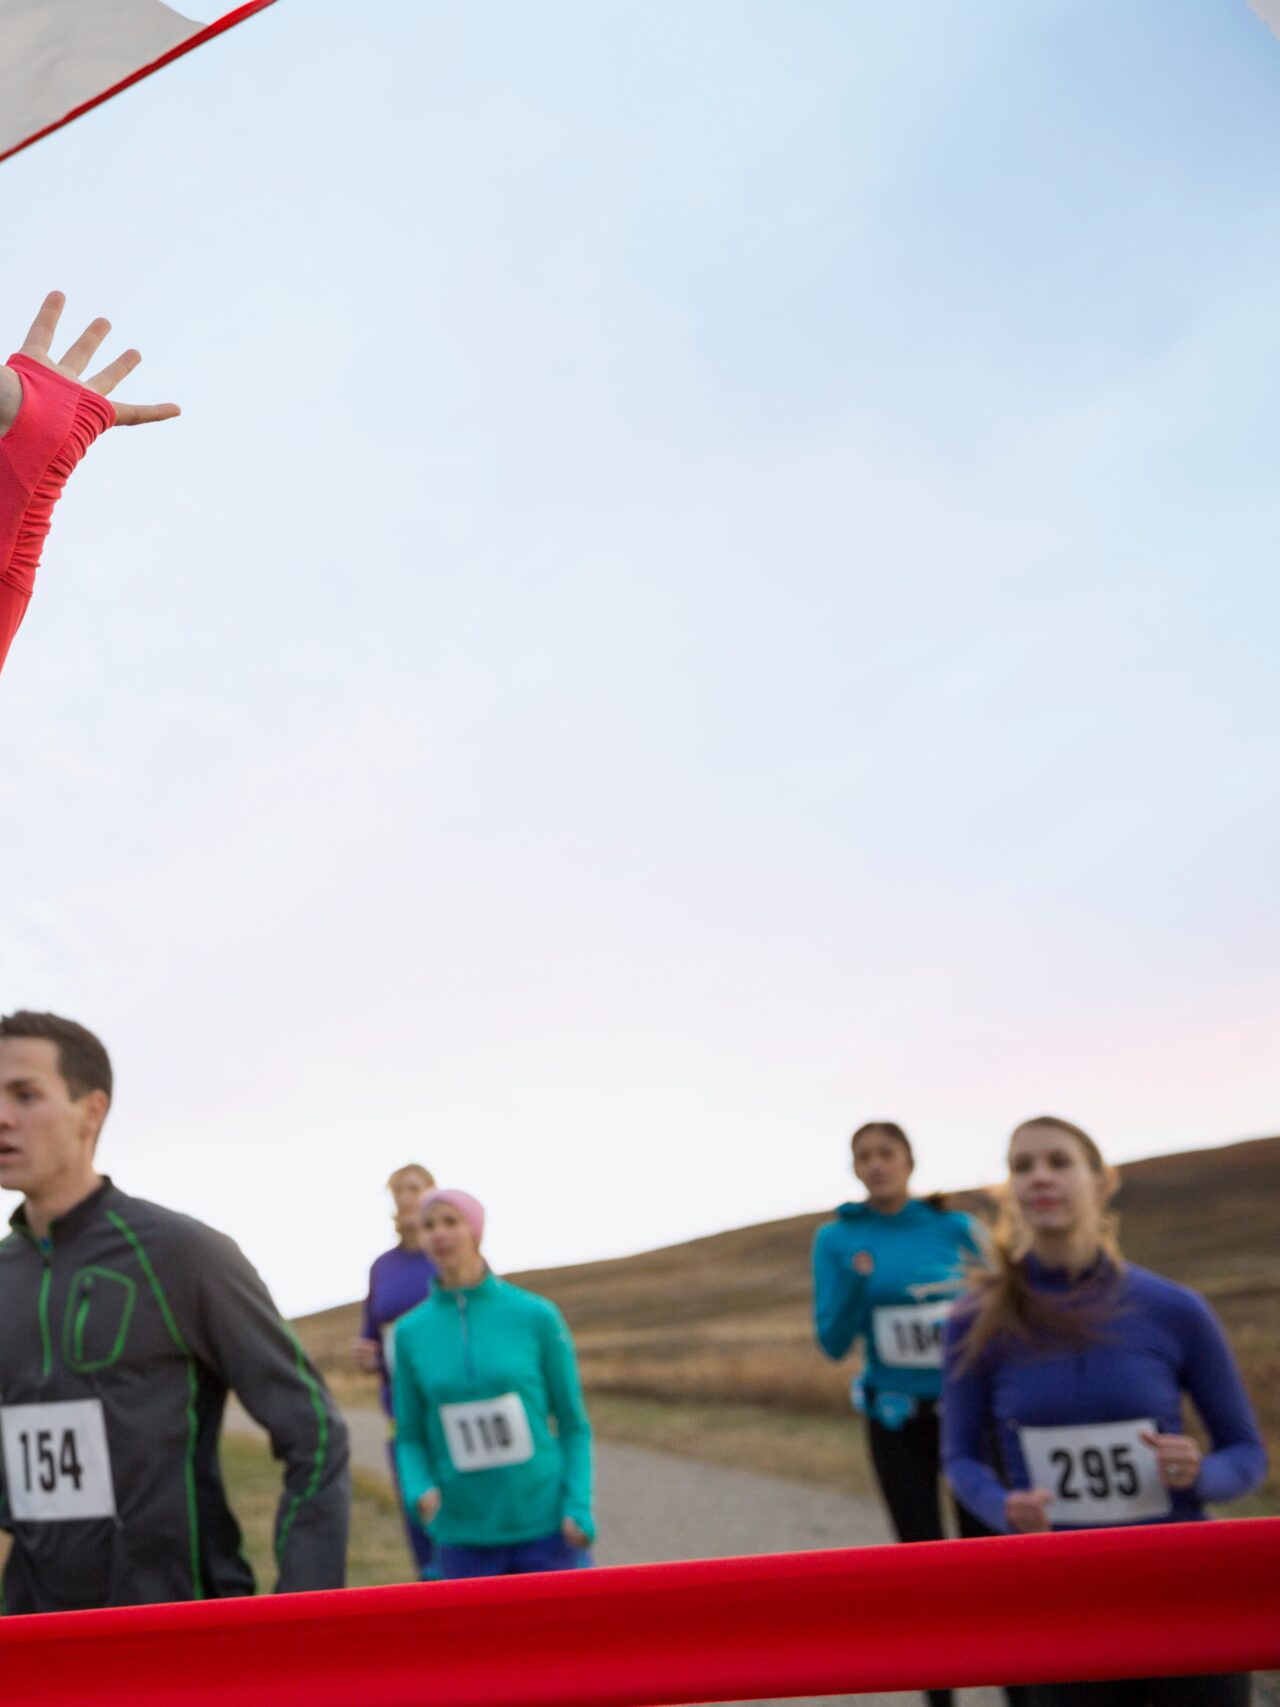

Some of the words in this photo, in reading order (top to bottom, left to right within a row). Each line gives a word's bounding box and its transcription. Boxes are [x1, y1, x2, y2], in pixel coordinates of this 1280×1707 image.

[18, 1428, 83, 1493] 154
[458, 1413, 513, 1455] 110
[1049, 1445, 1141, 1500] 295
